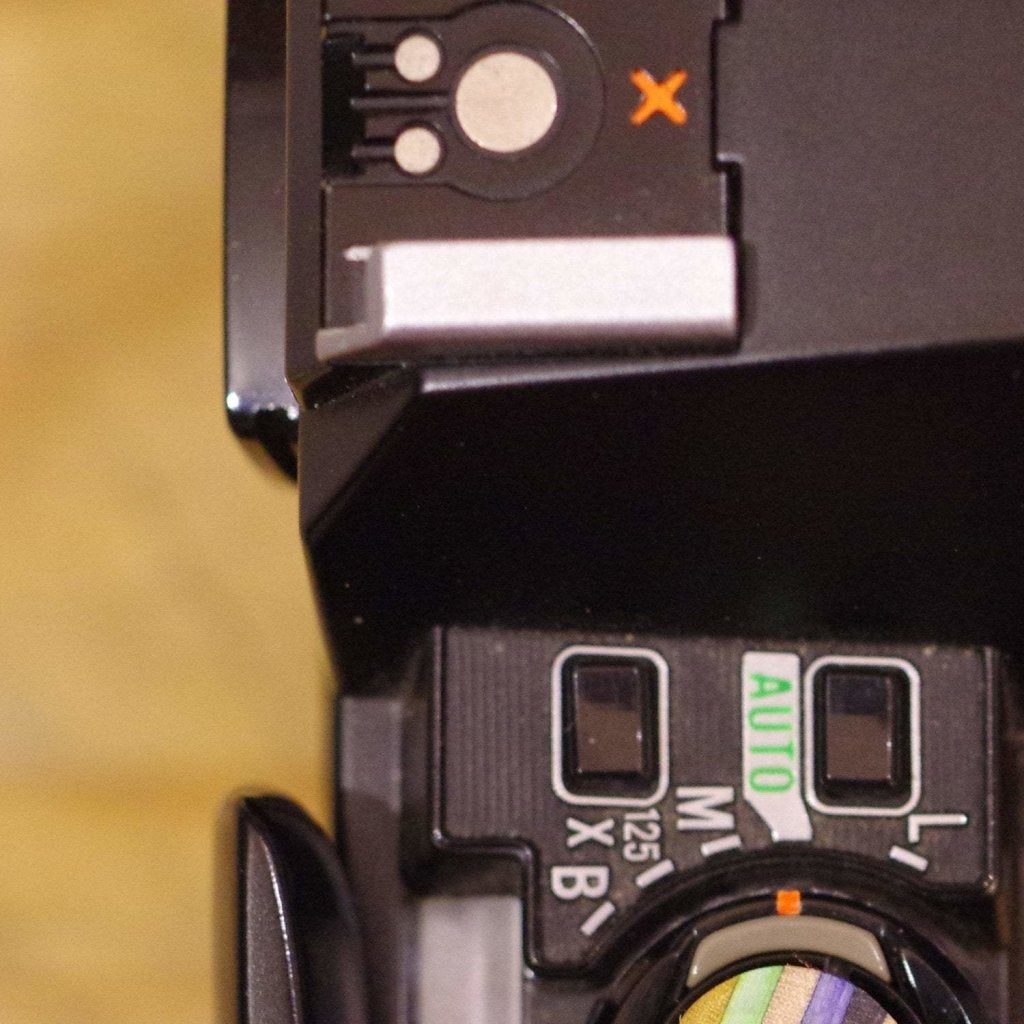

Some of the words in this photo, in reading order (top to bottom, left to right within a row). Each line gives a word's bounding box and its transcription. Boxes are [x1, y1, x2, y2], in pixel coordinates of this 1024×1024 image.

[747, 672, 795, 793] AUTO
[675, 786, 735, 831] M
[565, 817, 615, 849] X
[622, 808, 661, 863] 125
[908, 813, 968, 844] L
[550, 865, 609, 899] B
